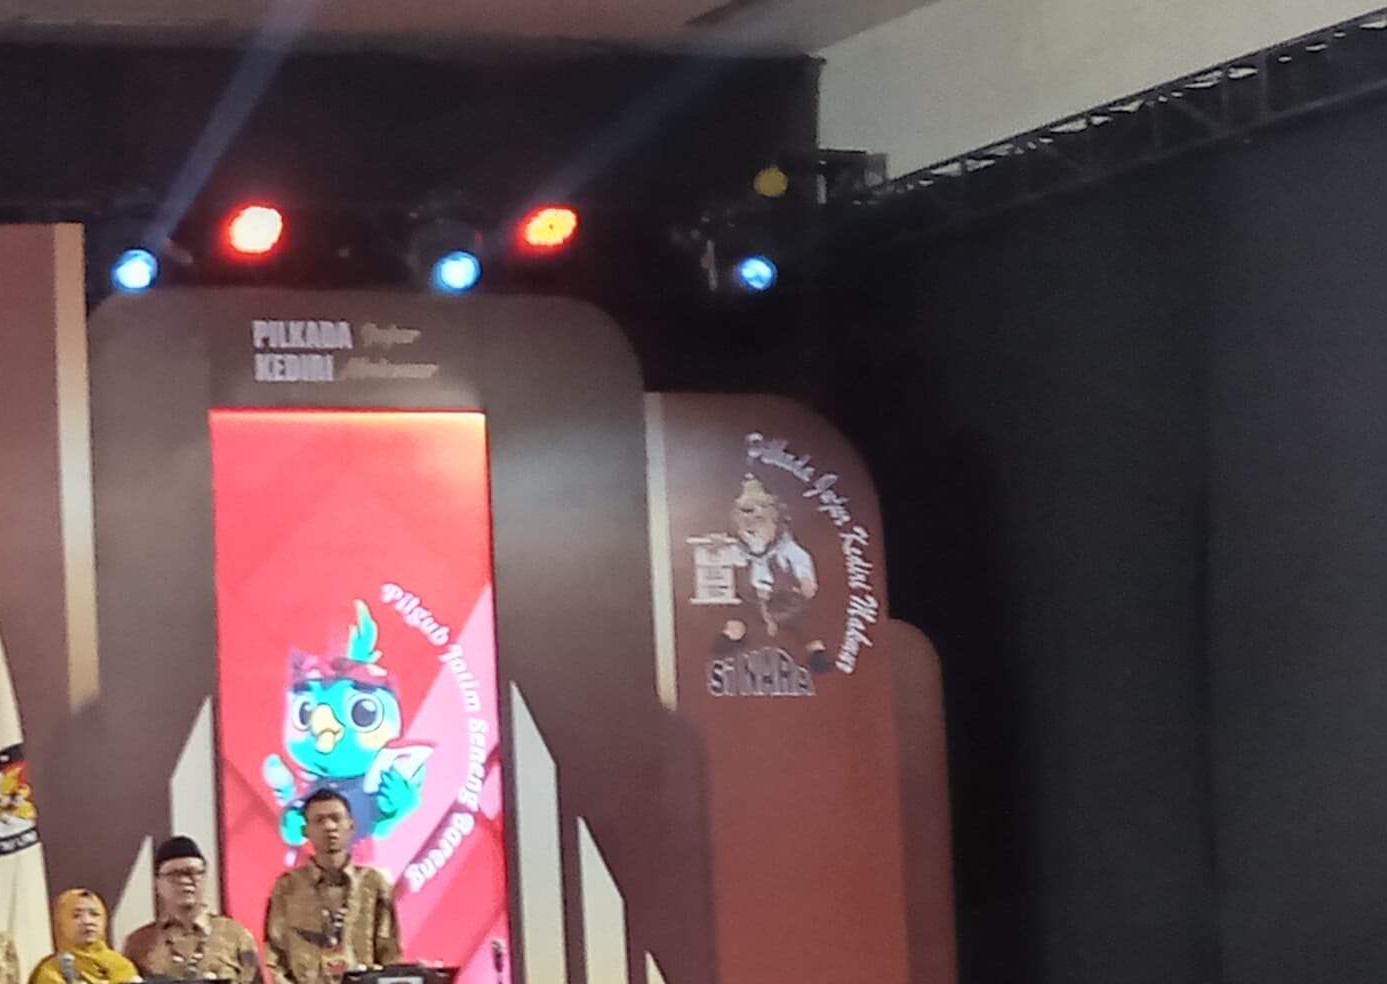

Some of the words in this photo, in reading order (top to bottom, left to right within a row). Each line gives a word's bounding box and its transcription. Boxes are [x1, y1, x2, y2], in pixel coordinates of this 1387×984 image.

[252, 320, 354, 349] PILKADA
[254, 353, 335, 382] KEDIRI
[380, 583, 450, 646] Pilgub
[438, 643, 481, 712] Jatim
[458, 717, 490, 813] Seneng
